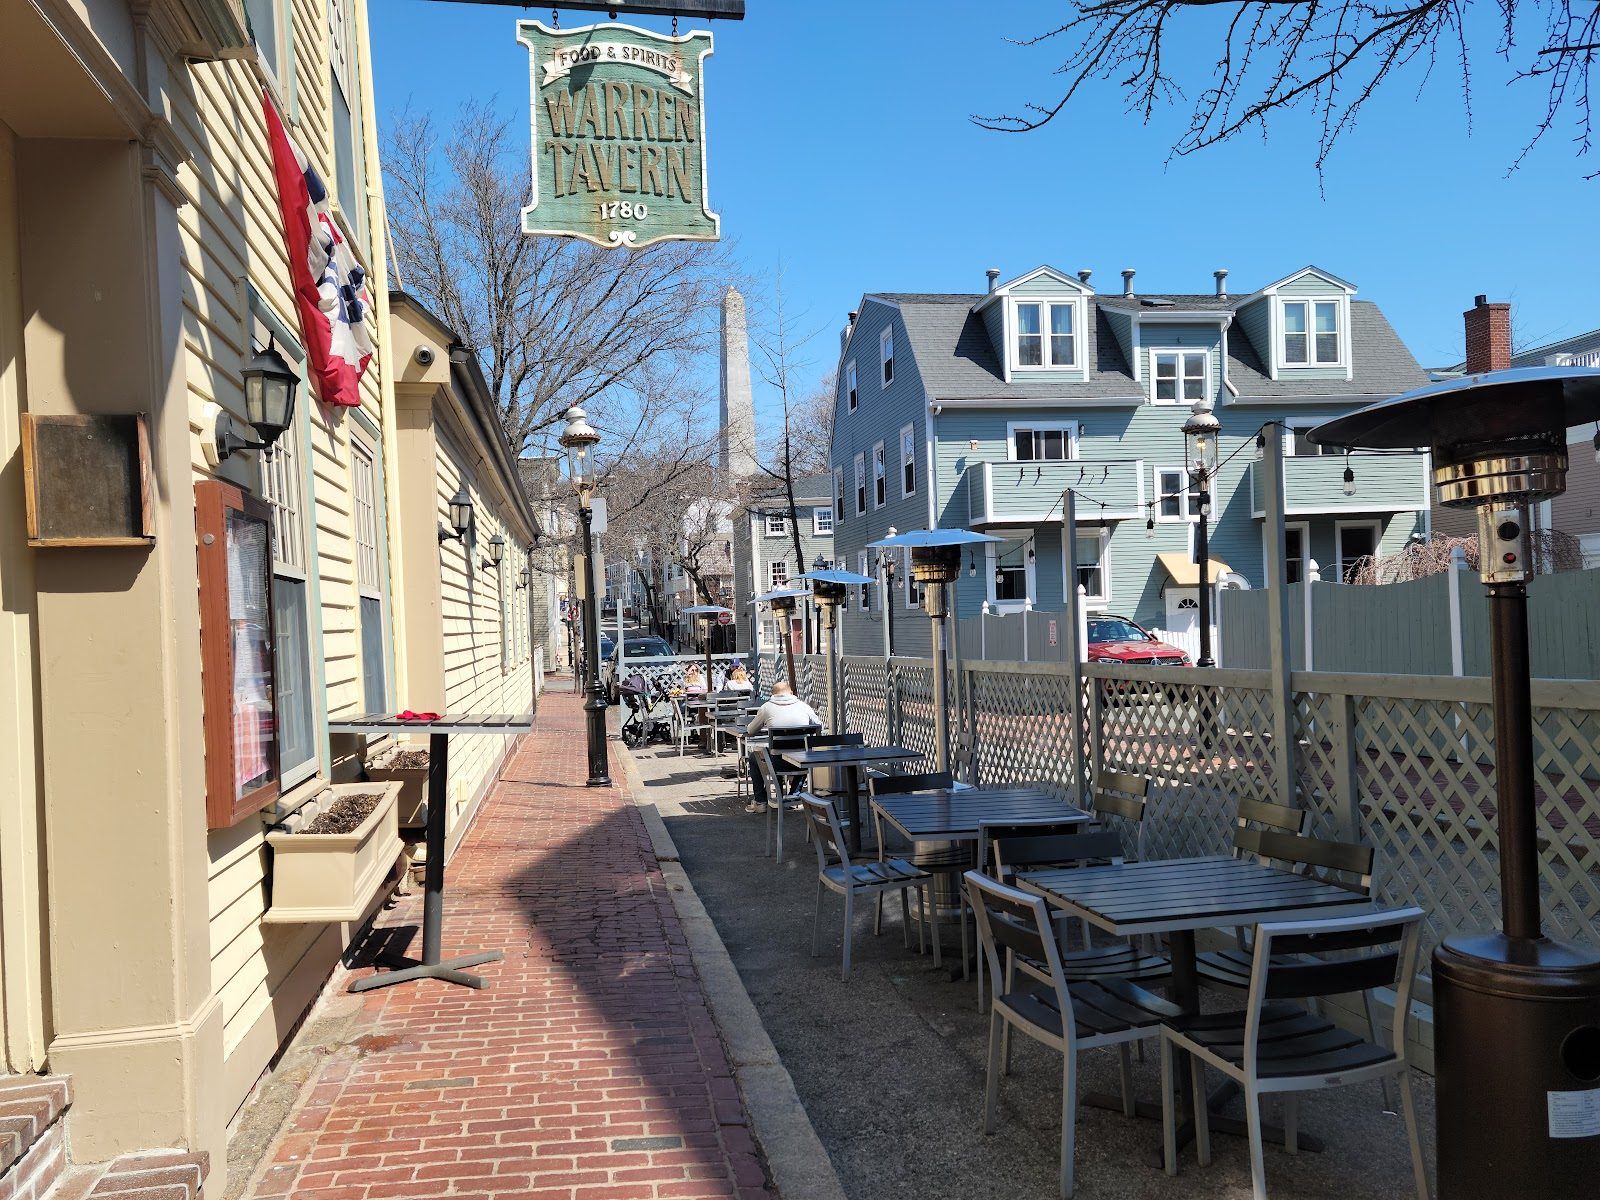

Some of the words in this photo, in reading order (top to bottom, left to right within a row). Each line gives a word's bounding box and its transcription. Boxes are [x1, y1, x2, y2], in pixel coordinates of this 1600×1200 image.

[560, 46, 600, 66] FOOD
[607, 46, 616, 59] &
[622, 46, 676, 73] SPIRITS
[544, 79, 696, 143] WARREN
[544, 140, 692, 204] TAVERN
[600, 201, 648, 220] 1780
